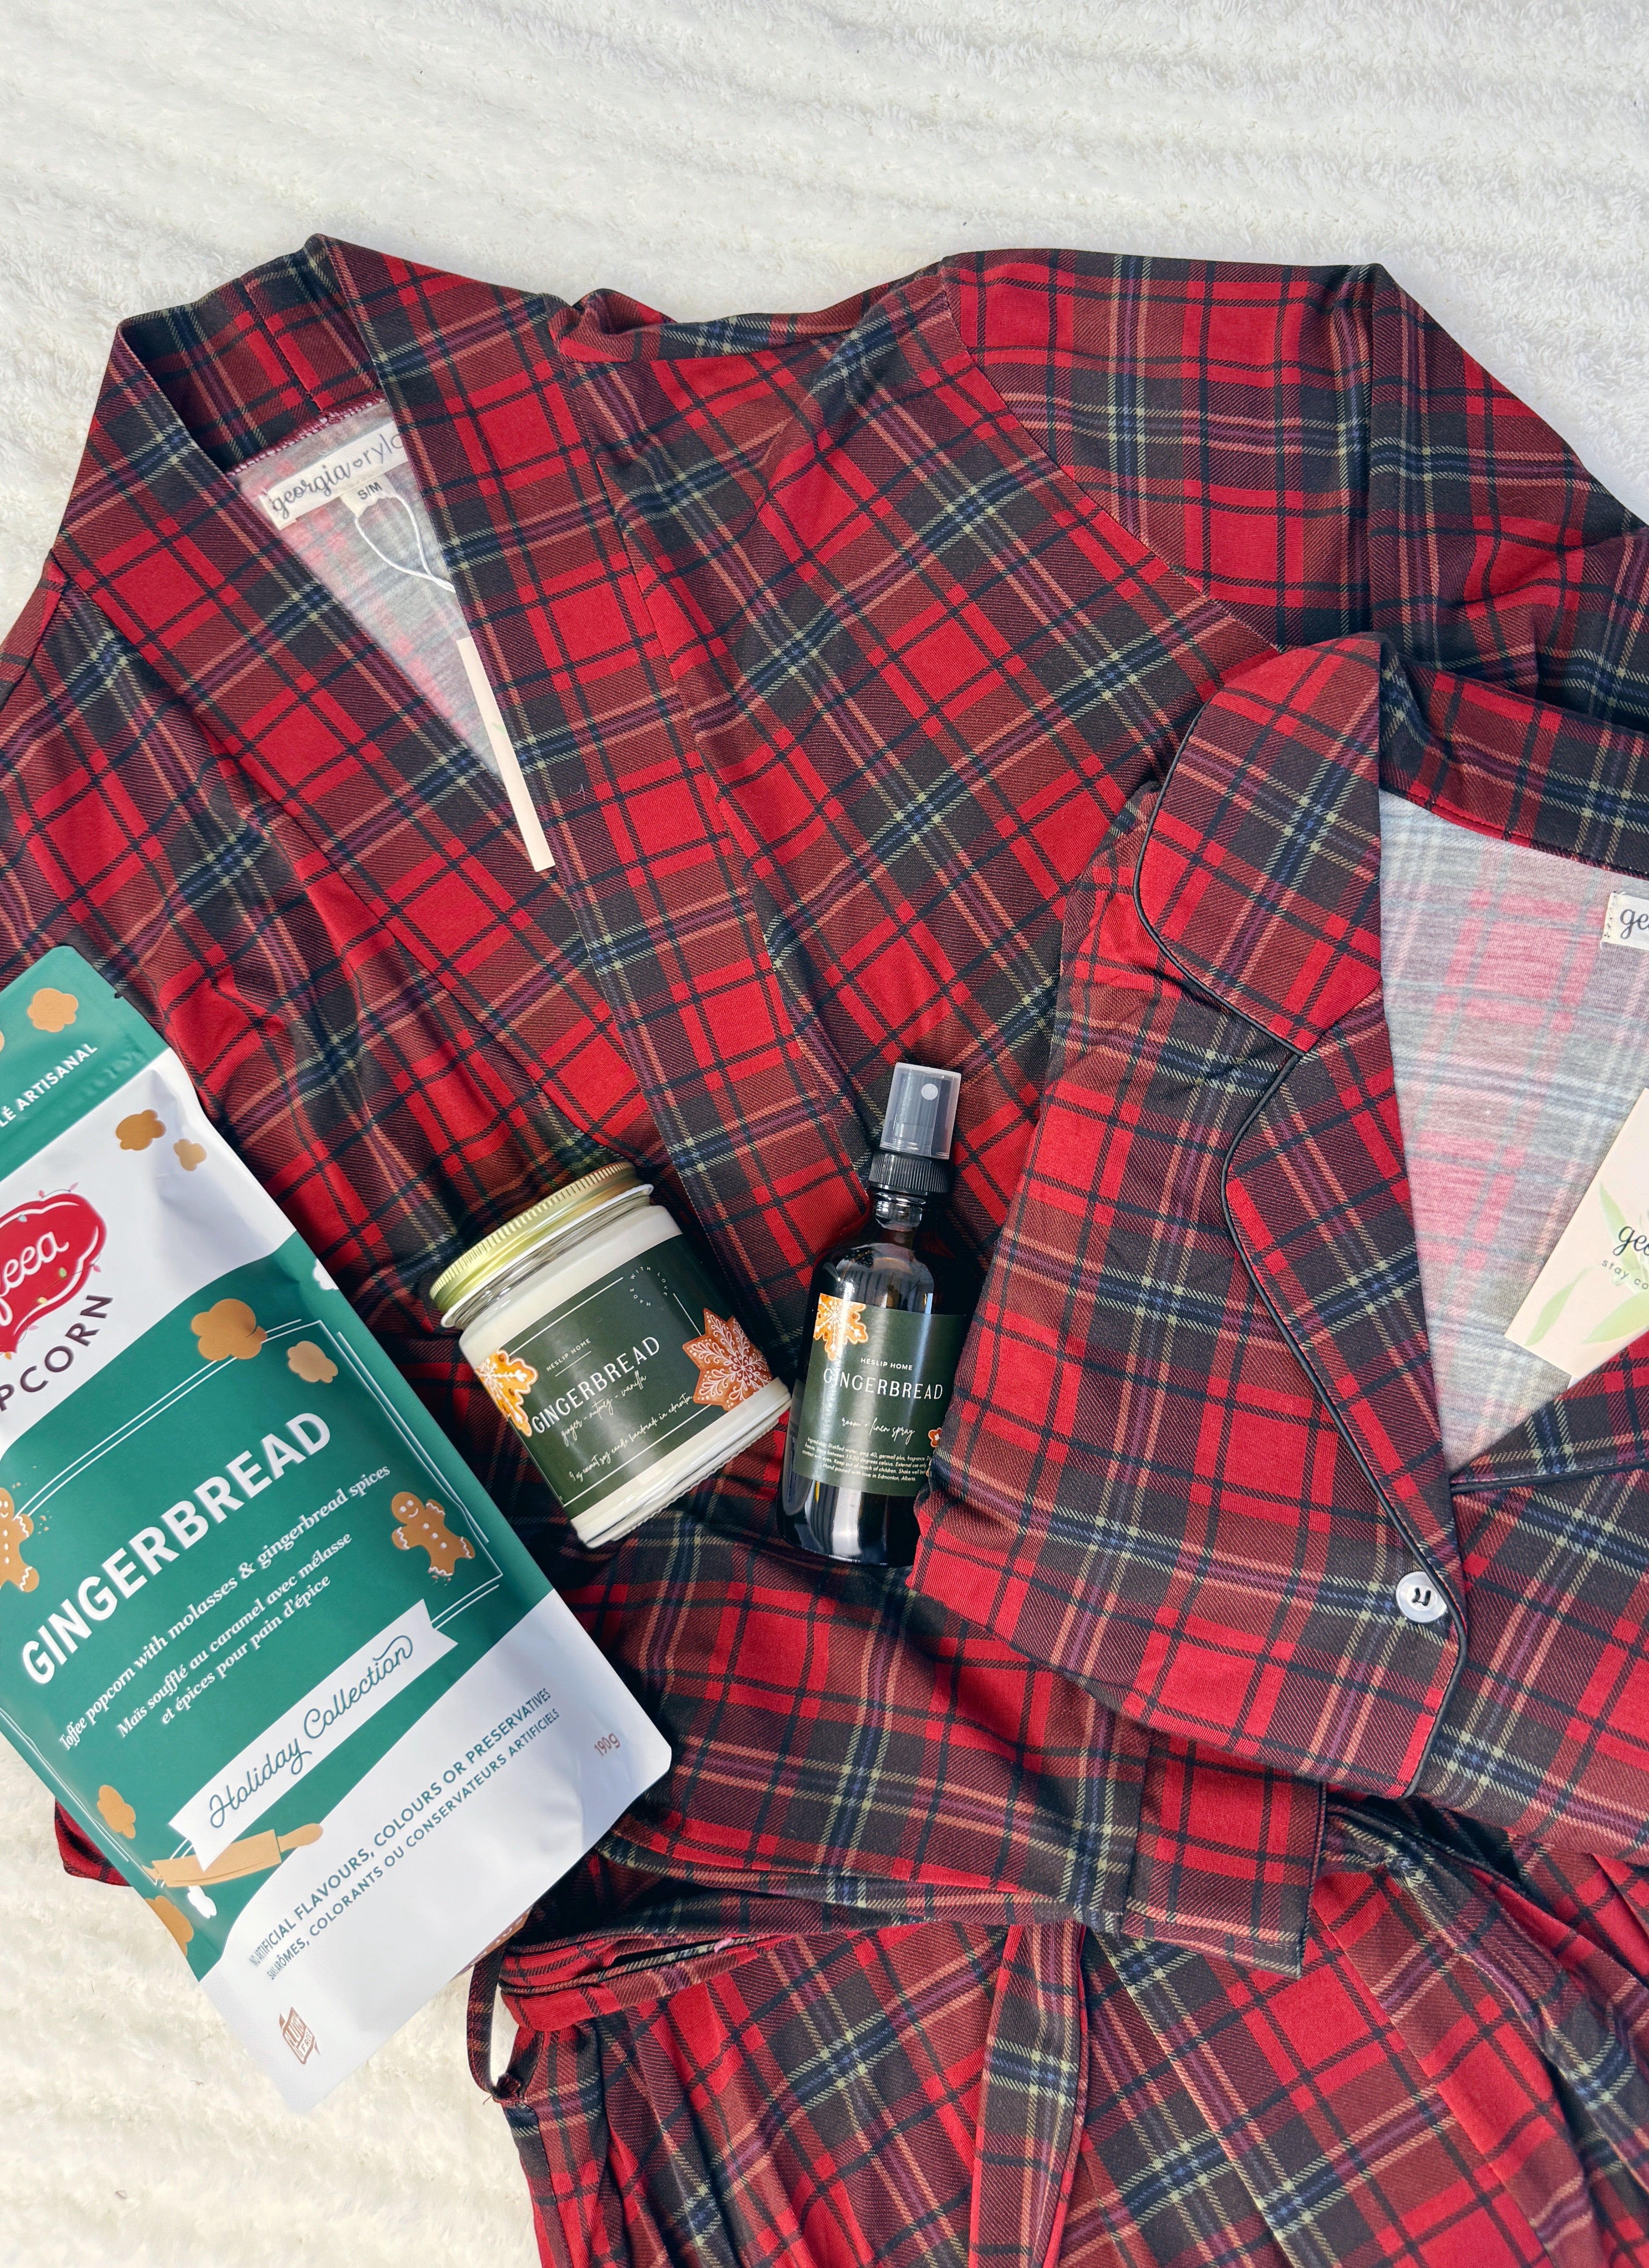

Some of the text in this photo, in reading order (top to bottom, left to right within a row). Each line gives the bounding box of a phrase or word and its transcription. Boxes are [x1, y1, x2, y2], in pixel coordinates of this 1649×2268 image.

[272, 462, 351, 520] georgia
[357, 482, 383, 500] S/M
[1620, 909, 1649, 939] ge
[15, 1043, 98, 1111] ARTISANAL
[630, 1267, 651, 1279] WITH
[658, 1272, 668, 1296] LOVE
[1602, 1260, 1629, 1280] stay
[546, 1338, 591, 1372] HESLIP HOME
[861, 1357, 888, 1367] HESLIP
[532, 1336, 660, 1433] GINGERBREAD
[561, 1419, 582, 1447] ginger
[621, 1370, 647, 1397] vanilla
[842, 1417, 861, 1427] room
[869, 1417, 890, 1435] linen
[892, 1427, 915, 1445] spray
[611, 1438, 629, 1453] candle
[629, 1417, 658, 1442] handmade
[827, 1449, 844, 1458] between
[860, 1456, 878, 1464] degrees
[22, 1412, 331, 1685] GINGERBREAD
[59, 1466, 391, 1751] Toffee popcorn with molasses & gingerbread spices
[117, 1533, 352, 1738] Maïs soufflé au caramel avec mélasse
[162, 1576, 331, 1724] et épices pour pain d'épice
[210, 1635, 413, 1828] Holiday Collection
[594, 1732, 620, 1756] 190g
[249, 1687, 551, 1967] NO ARTIFICIAL FLAVOURS, COLOURS OR PRESERVATIVES
[274, 1937, 310, 1972] ARÔMES,
[310, 1866, 383, 1936] COLORANTS
[384, 1846, 404, 1867] OU
[406, 1754, 506, 1847] CONSERVATEURS
[508, 1708, 560, 1757] ARTIFICIELS
[301, 2032, 311, 2052] FREE
